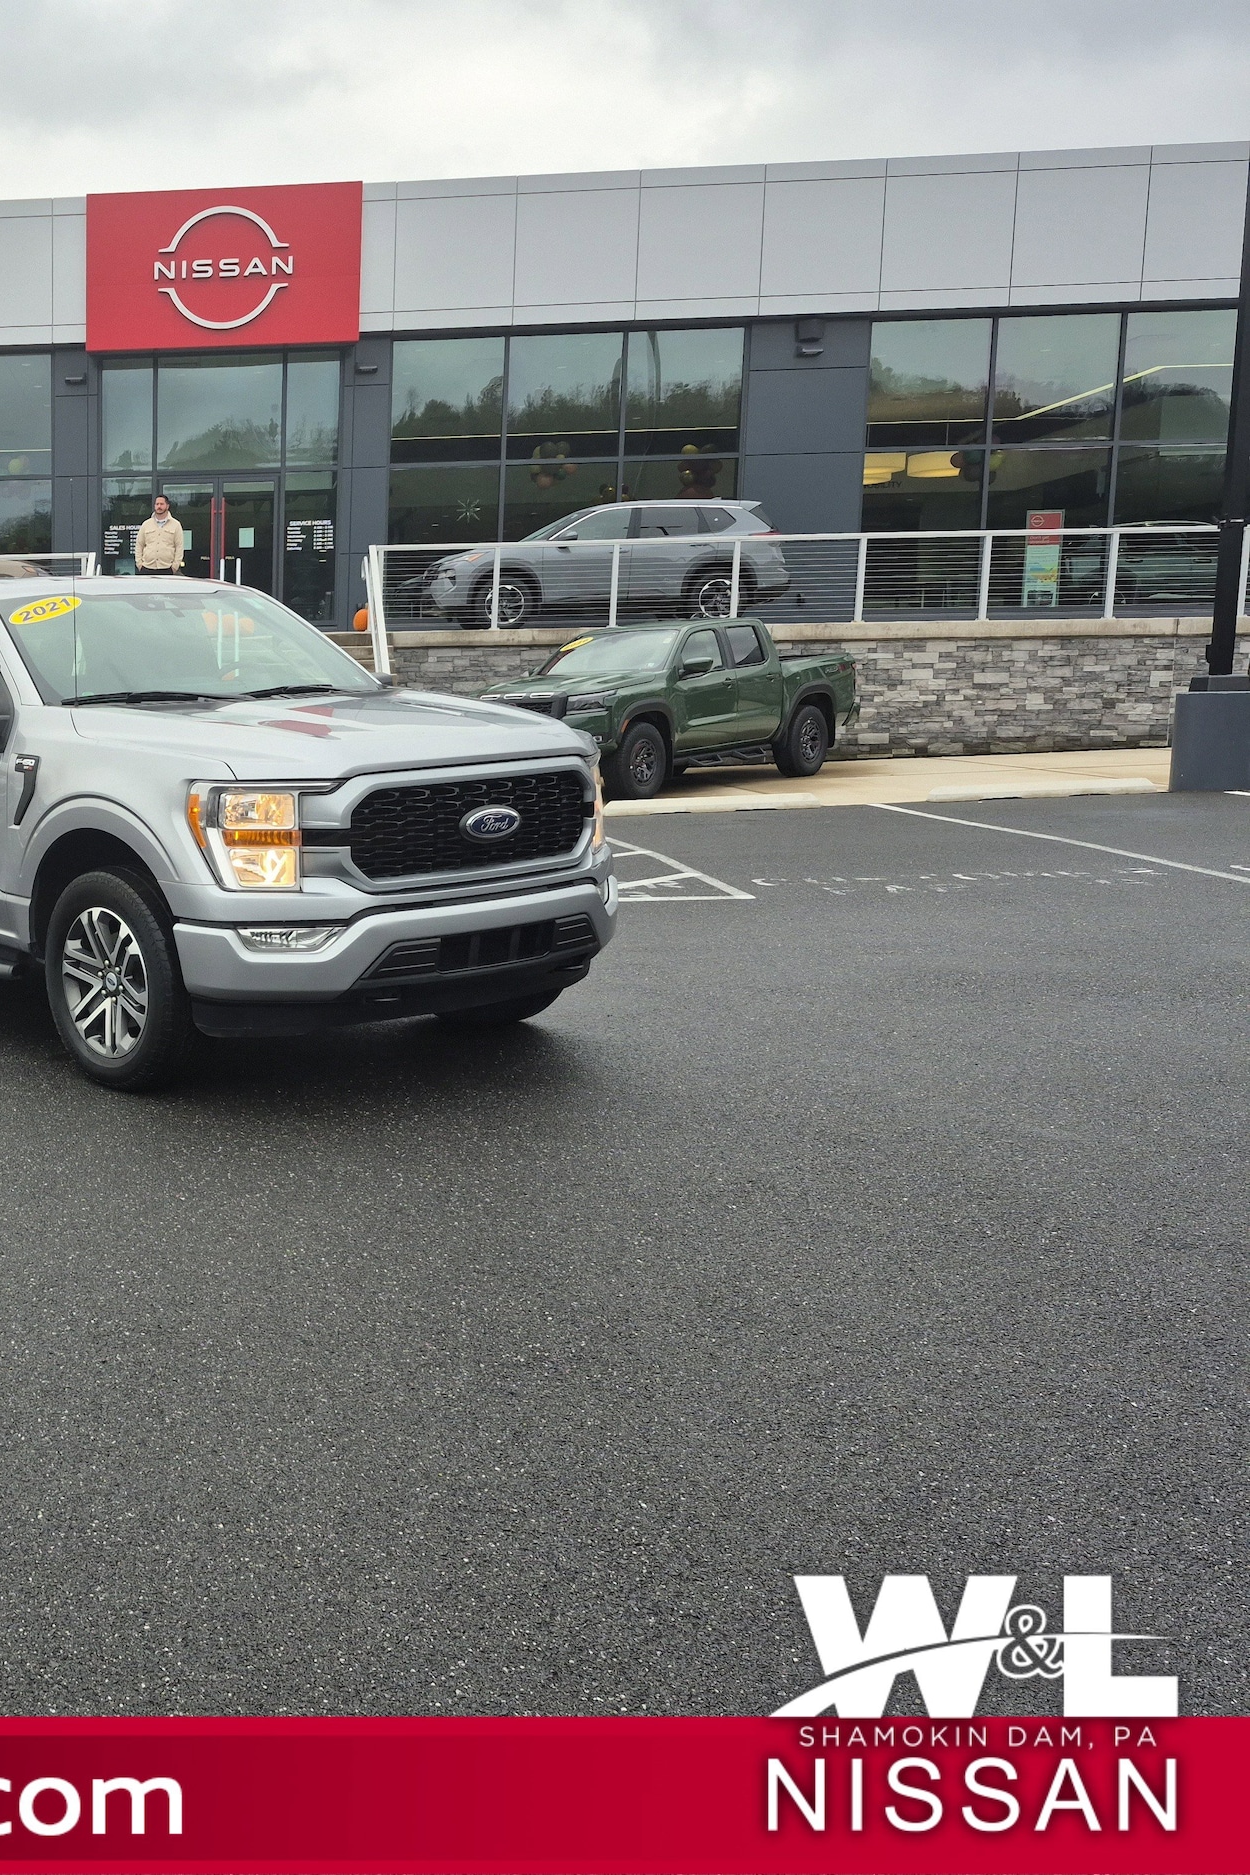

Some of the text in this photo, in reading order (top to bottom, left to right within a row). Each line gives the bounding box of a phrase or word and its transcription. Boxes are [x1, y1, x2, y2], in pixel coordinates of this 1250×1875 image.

[153, 255, 294, 281] NISSAN
[18, 598, 71, 622] 2021
[481, 814, 510, 832] Ford
